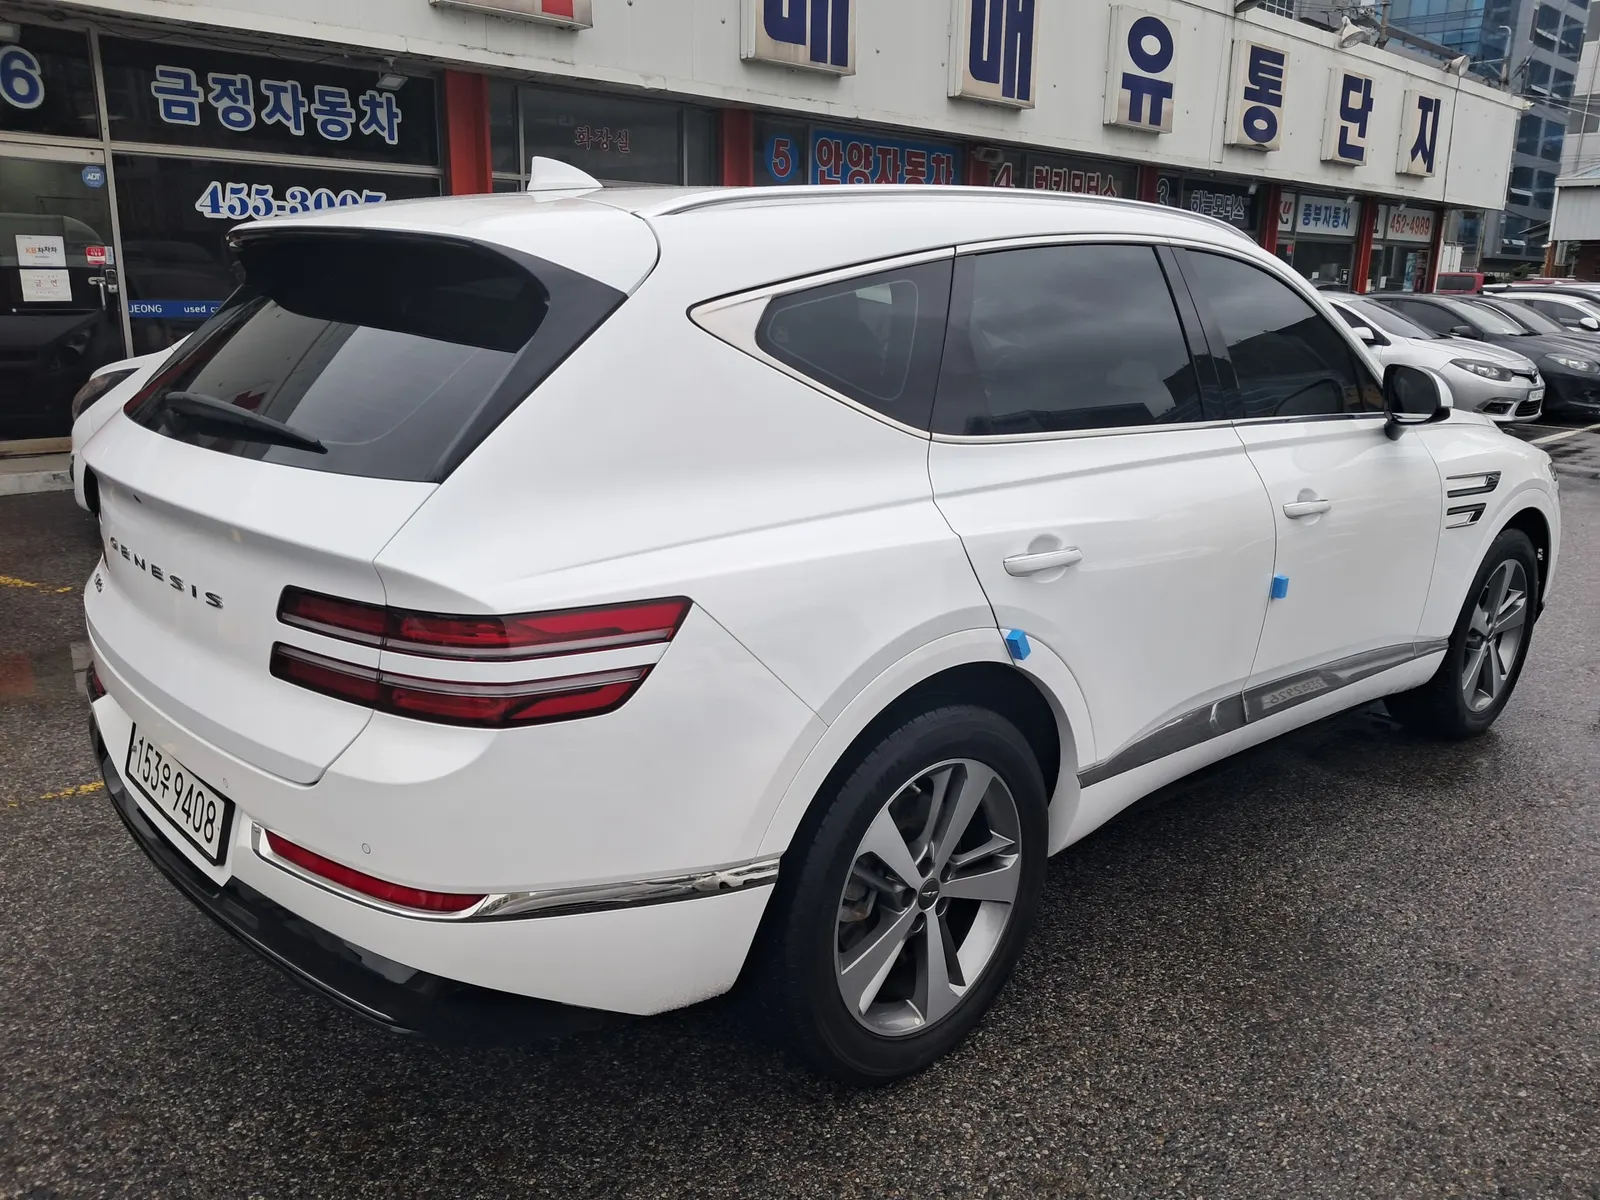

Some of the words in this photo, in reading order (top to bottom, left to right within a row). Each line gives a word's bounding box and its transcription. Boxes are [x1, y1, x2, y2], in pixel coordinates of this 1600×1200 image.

[0, 45, 44, 109] 6
[151, 65, 401, 145] 금정자동차
[574, 125, 631, 153] 화장실
[772, 138, 792, 178] 5
[816, 137, 953, 184] 안양자동차
[993, 162, 1015, 188] 4
[1191, 190, 1244, 220] 하늘모터스
[1302, 203, 1350, 230] 중부자동차
[1390, 213, 1430, 236] 452-4989
[129, 304, 162, 313] JEONG
[183, 304, 206, 313] used
[109, 536, 223, 609] GENESIS
[137, 736, 217, 844] 153우9408
